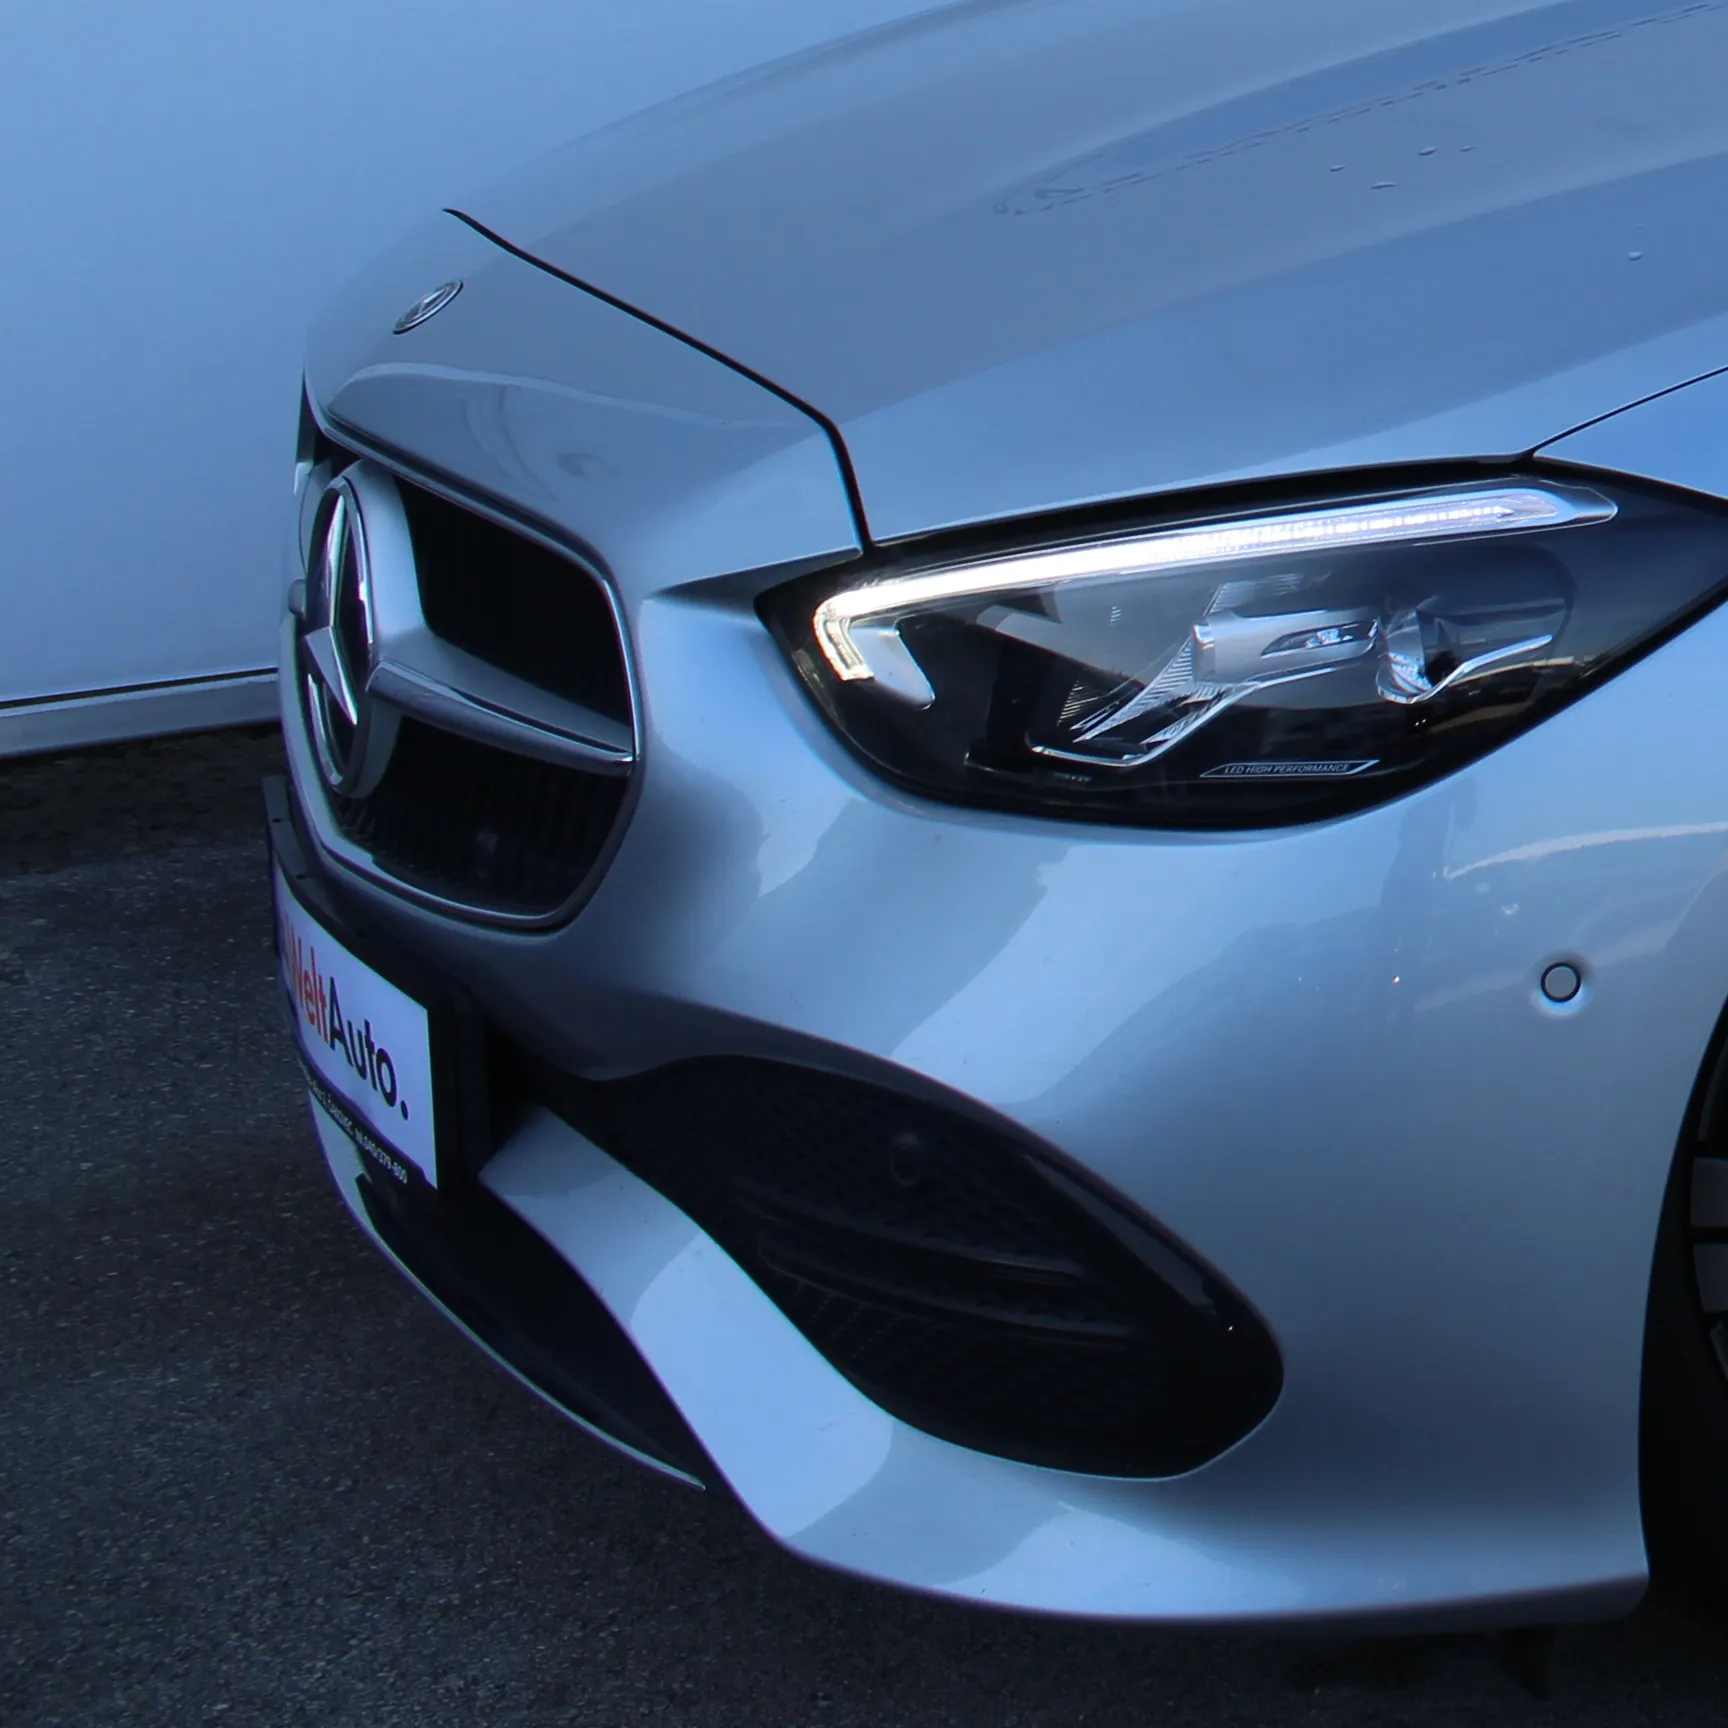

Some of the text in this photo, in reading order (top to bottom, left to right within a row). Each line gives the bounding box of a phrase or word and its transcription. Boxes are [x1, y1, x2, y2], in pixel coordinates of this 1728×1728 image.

[1224, 762, 1348, 775] LED HIGH PERFORMANCE
